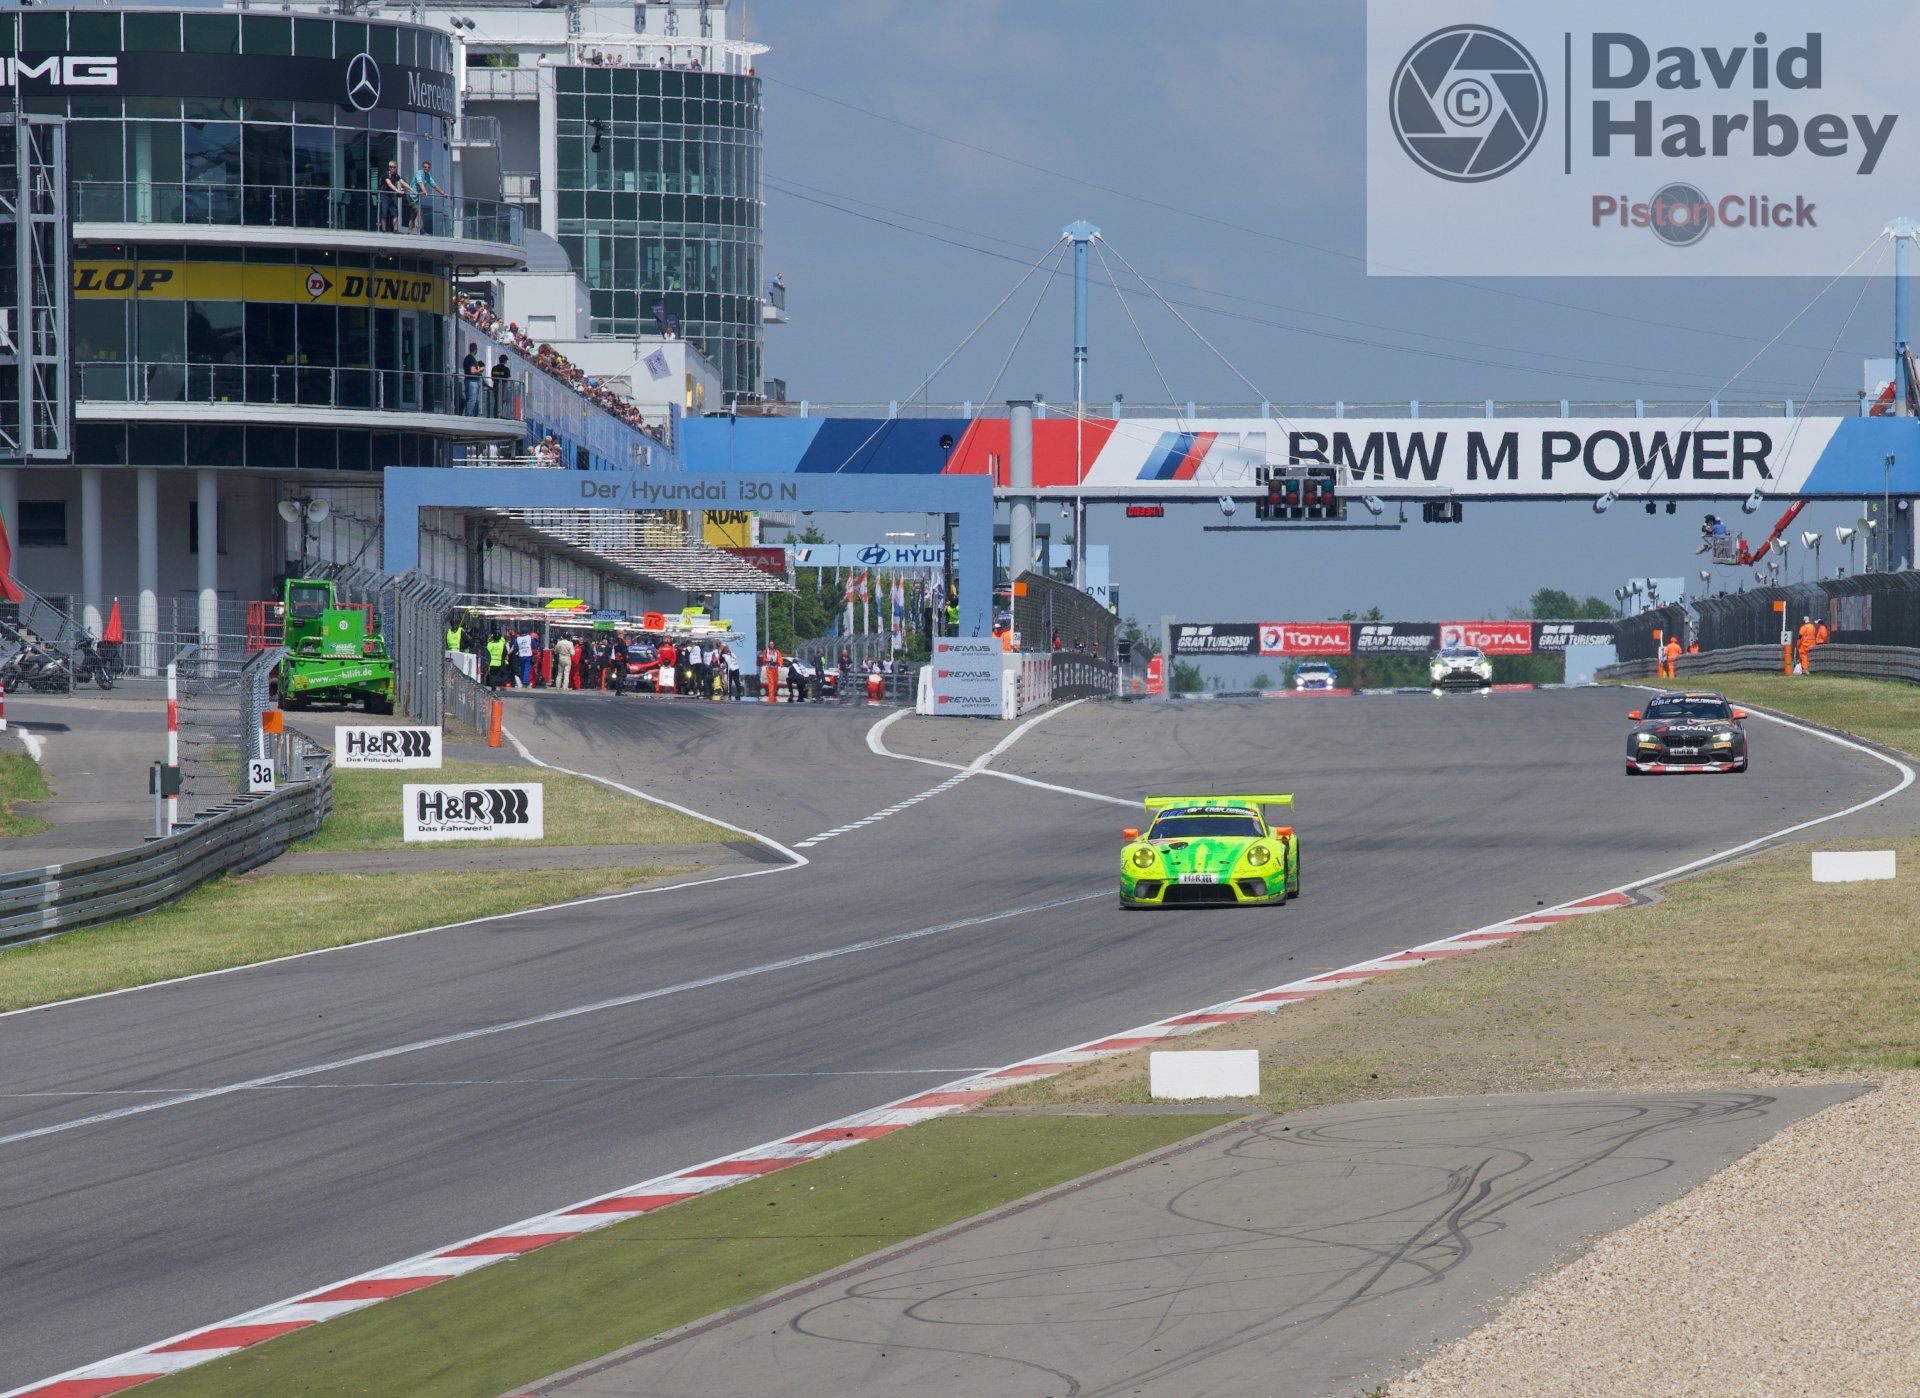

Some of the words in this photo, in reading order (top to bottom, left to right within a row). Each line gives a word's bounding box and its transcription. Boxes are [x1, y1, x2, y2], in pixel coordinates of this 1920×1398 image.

[0, 56, 118, 85] MG
[74, 269, 173, 291] LOP
[341, 276, 431, 303] DUNLOP
[1289, 432, 1448, 480] BMW
[1467, 432, 1518, 480] M
[1542, 430, 1773, 481] POWER
[581, 480, 620, 498] Der
[632, 480, 726, 503] Hyundai
[739, 481, 773, 500] i30
[781, 482, 797, 500] N
[747, 555, 782, 566] TAL
[1178, 636, 1206, 647] GRAN
[1284, 632, 1346, 646] TOTAL
[1466, 630, 1528, 646] TOTAL
[1539, 635, 1567, 645] GRAN
[346, 731, 400, 756] H&R
[253, 764, 272, 783] 3a
[417, 790, 491, 825] H&R
